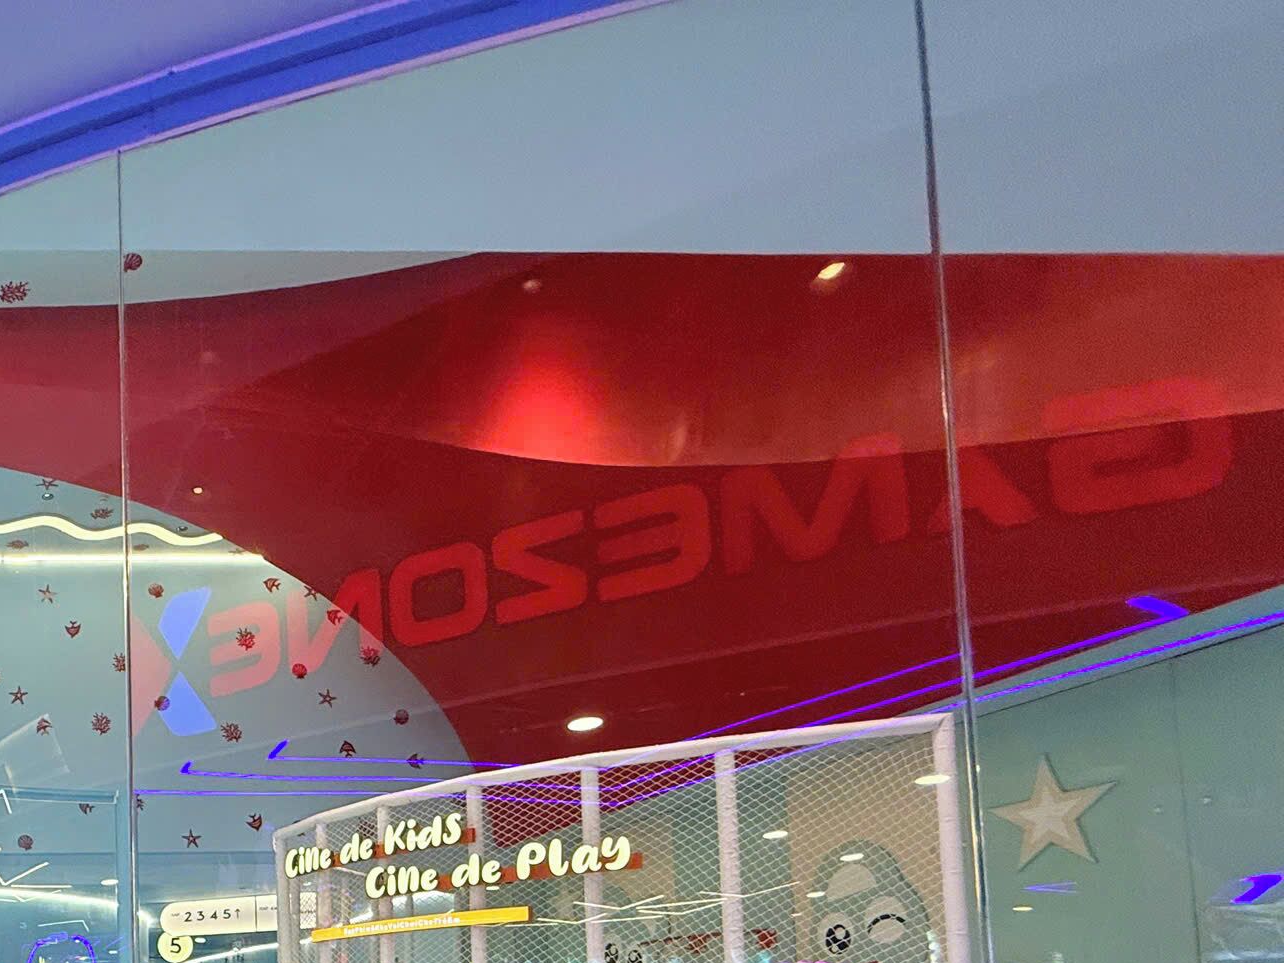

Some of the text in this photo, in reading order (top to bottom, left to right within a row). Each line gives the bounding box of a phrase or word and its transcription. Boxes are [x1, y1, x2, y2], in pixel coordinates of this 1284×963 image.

[285, 847, 332, 879] Cine
[339, 833, 373, 865] de
[364, 835, 631, 899] Cine de Play
[184, 911, 193, 923] 2
[196, 910, 206, 921] 3
[209, 909, 218, 921] 4
[222, 908, 232, 920] 5
[169, 937, 182, 954] 5
